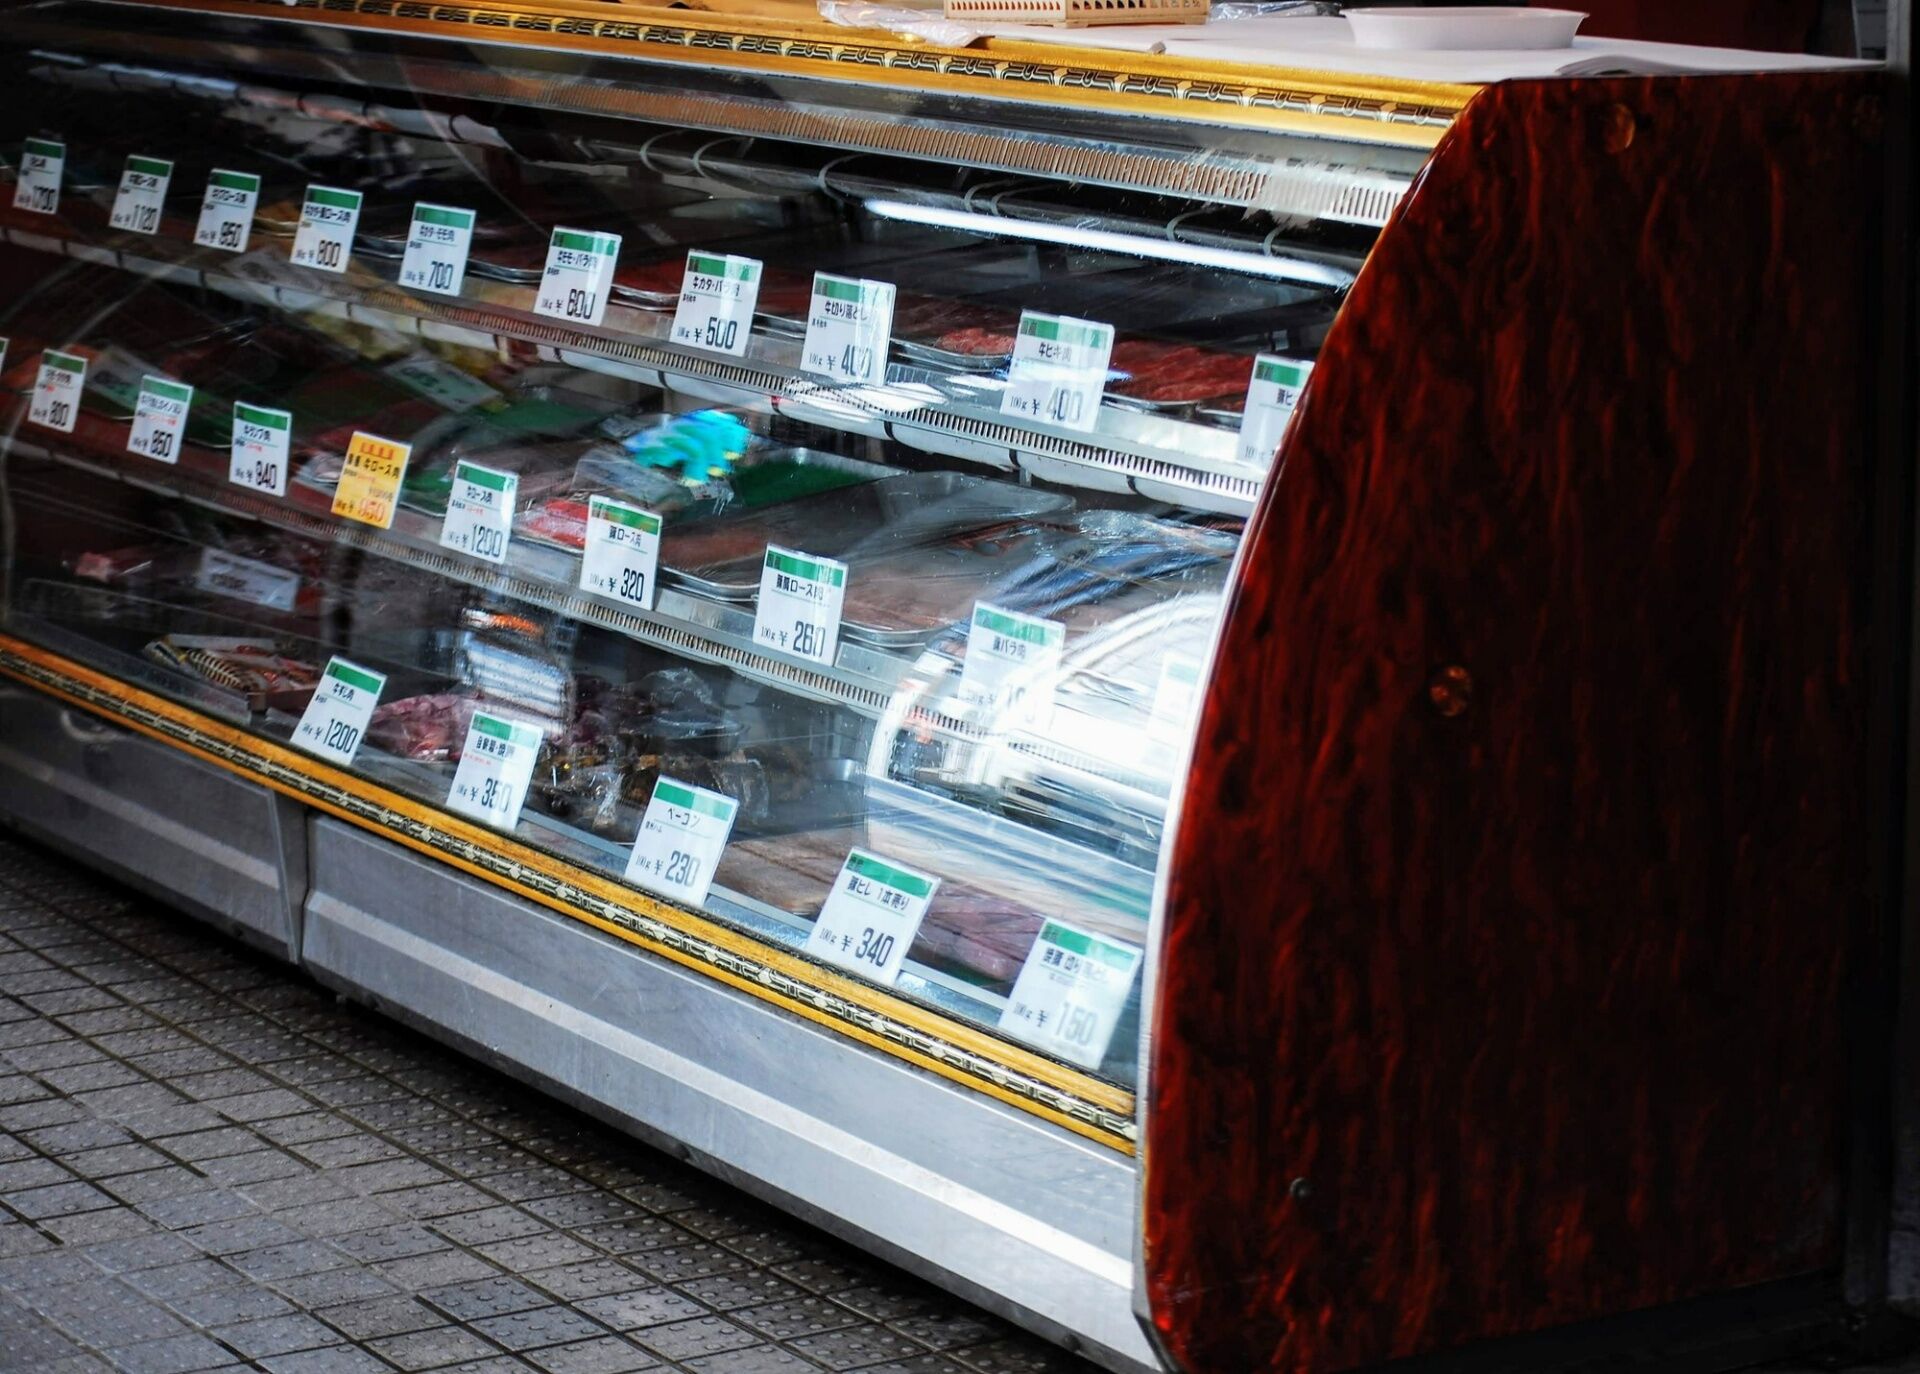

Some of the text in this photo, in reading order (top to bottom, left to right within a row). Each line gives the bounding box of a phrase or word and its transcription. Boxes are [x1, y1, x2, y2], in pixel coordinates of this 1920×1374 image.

[428, 261, 454, 290] 700
[706, 316, 738, 350] 500
[841, 344, 873, 379] 400
[1046, 386, 1085, 424] 400
[471, 523, 503, 558] 1200
[620, 568, 645, 602] 320
[794, 621, 826, 657] 260
[324, 718, 358, 754] 1200
[482, 778, 513, 814] 350
[667, 808, 701, 829] ベーコン
[666, 850, 700, 887] 230
[855, 927, 894, 968] 340
[1057, 1001, 1097, 1046] 150
